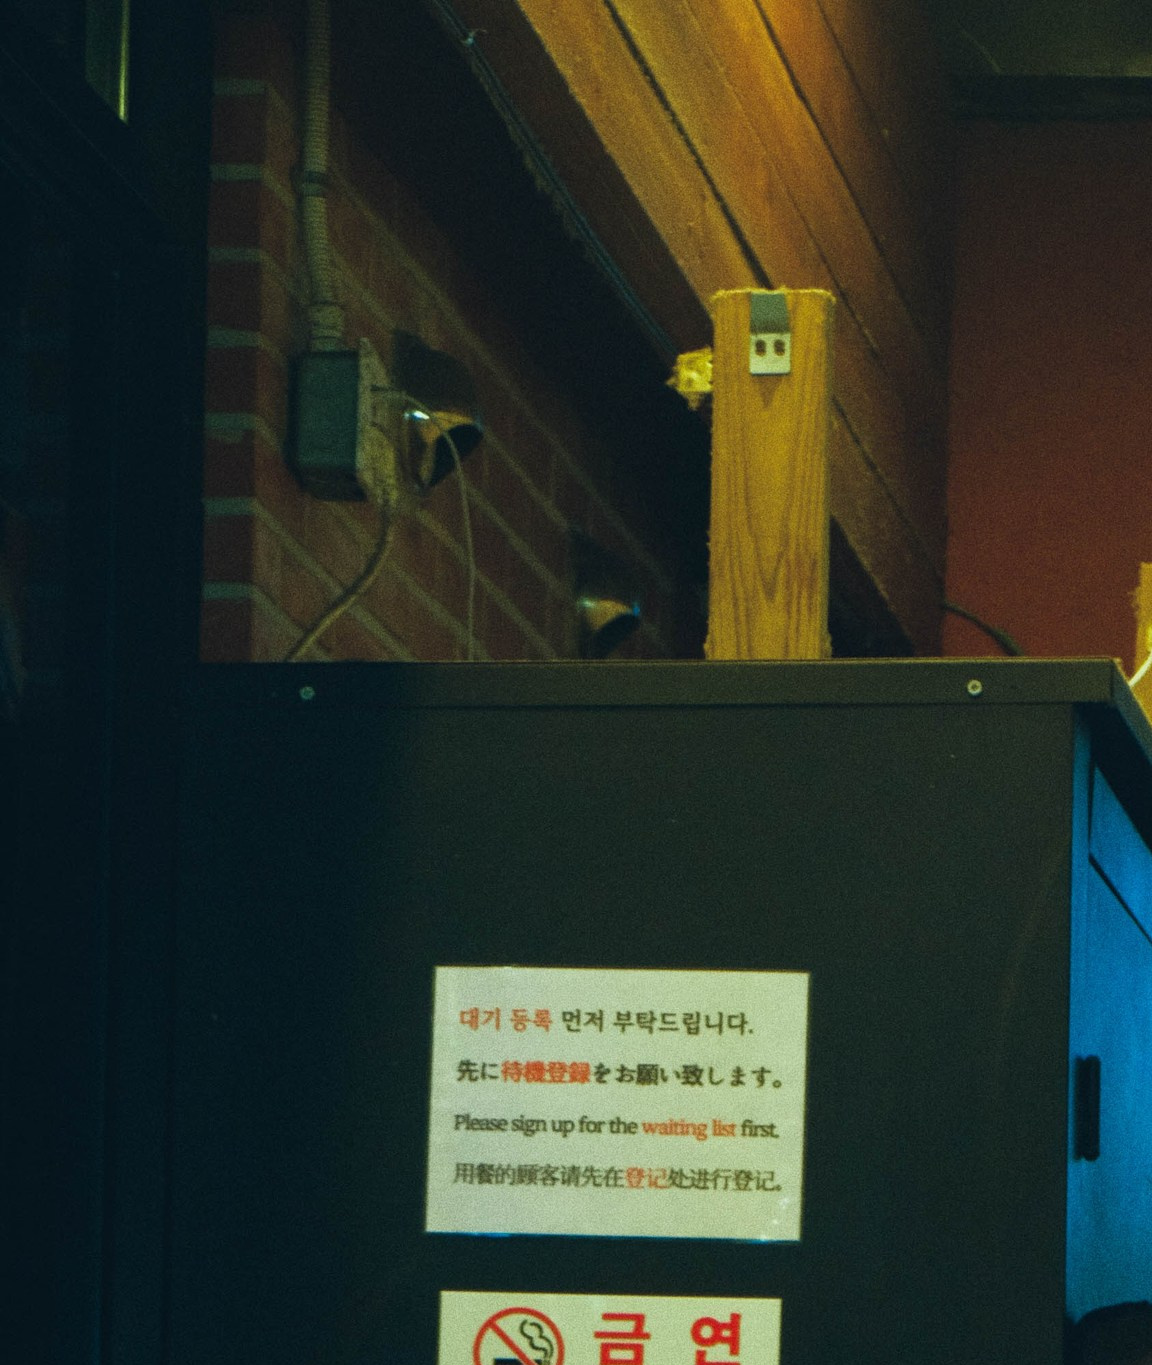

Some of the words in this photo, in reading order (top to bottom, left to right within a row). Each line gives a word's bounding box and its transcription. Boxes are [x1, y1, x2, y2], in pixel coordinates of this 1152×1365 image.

[459, 1006, 501, 1031] 대기
[509, 1008, 553, 1033] 등록
[561, 1008, 605, 1033] 먼저
[613, 1010, 754, 1036] 부탁드립니다.
[453, 1113, 508, 1132] Please
[510, 1114, 548, 1137] sign
[551, 1119, 576, 1138] up
[577, 1115, 606, 1134] for
[608, 1116, 639, 1135] the
[641, 1118, 708, 1142] waiting
[711, 1119, 737, 1137] list
[740, 1119, 780, 1139] first.
